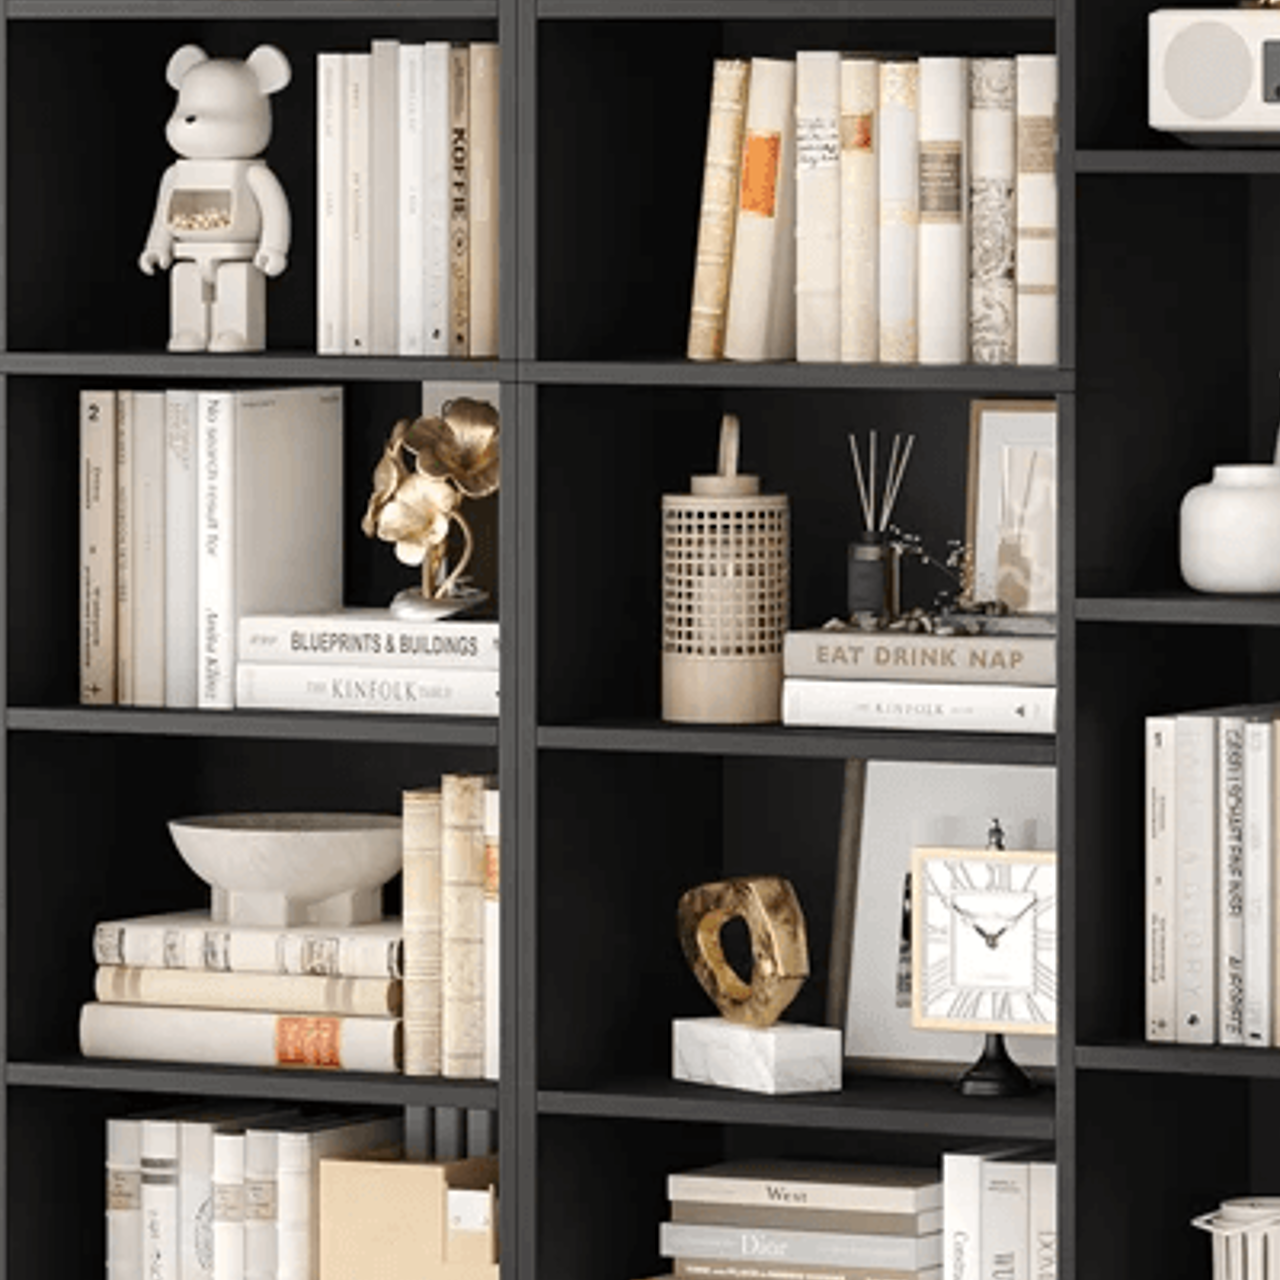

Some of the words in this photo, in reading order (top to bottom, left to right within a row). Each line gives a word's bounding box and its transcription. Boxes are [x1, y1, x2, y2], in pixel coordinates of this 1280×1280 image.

[205, 399, 219, 423] No
[205, 427, 219, 481] search
[205, 485, 219, 530] result
[205, 533, 219, 557] for
[290, 630, 380, 654] BLUEPRINTS
[383, 634, 395, 654] &
[399, 633, 478, 657] BUILDINGS
[816, 646, 864, 664] EAT
[875, 646, 956, 667] DRINK
[969, 649, 1024, 669] NAP
[332, 677, 417, 702] KINFOLK
[765, 1185, 808, 1204] West
[740, 1233, 789, 1257] Dior
